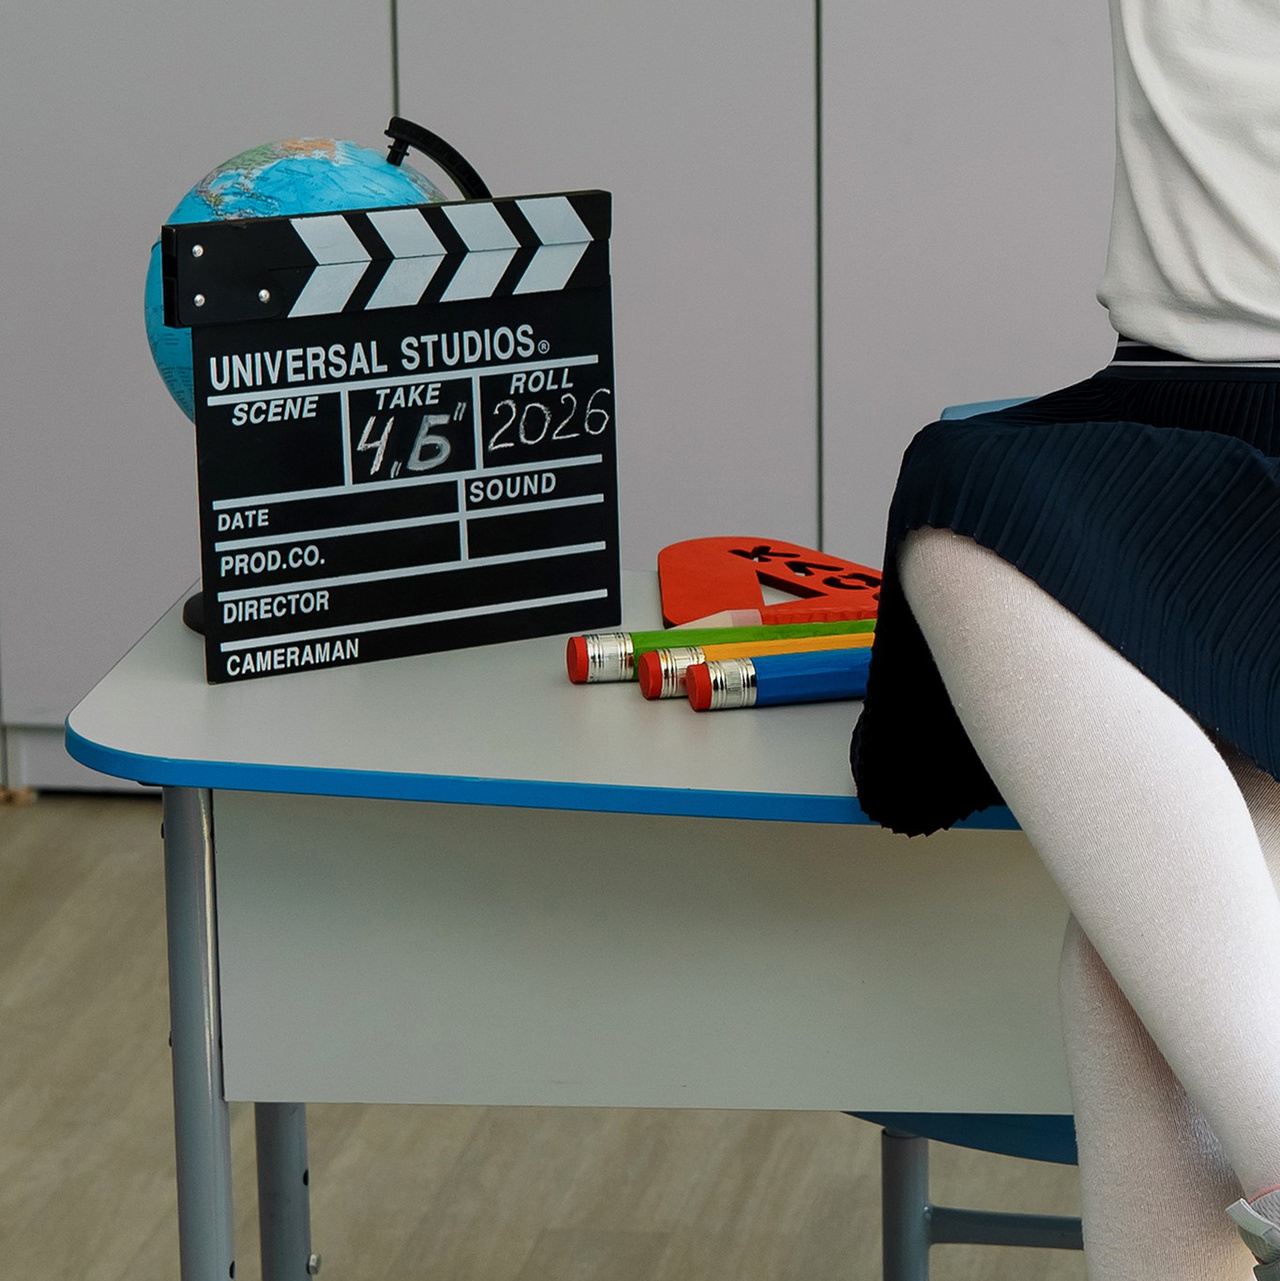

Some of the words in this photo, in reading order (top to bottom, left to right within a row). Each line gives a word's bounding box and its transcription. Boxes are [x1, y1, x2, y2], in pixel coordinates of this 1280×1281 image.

[209, 341, 388, 391] UNIVERSAL
[509, 367, 574, 395] ROLL
[231, 395, 319, 427] SCENE
[375, 382, 442, 411] TAKE
[487, 387, 611, 452] 2026
[469, 472, 556, 503] SOUND
[217, 508, 270, 532] DATE
[220, 544, 326, 578] PROD.CO.
[223, 589, 331, 625] DIRECTOR
[226, 637, 360, 676] CAMERAMAN
